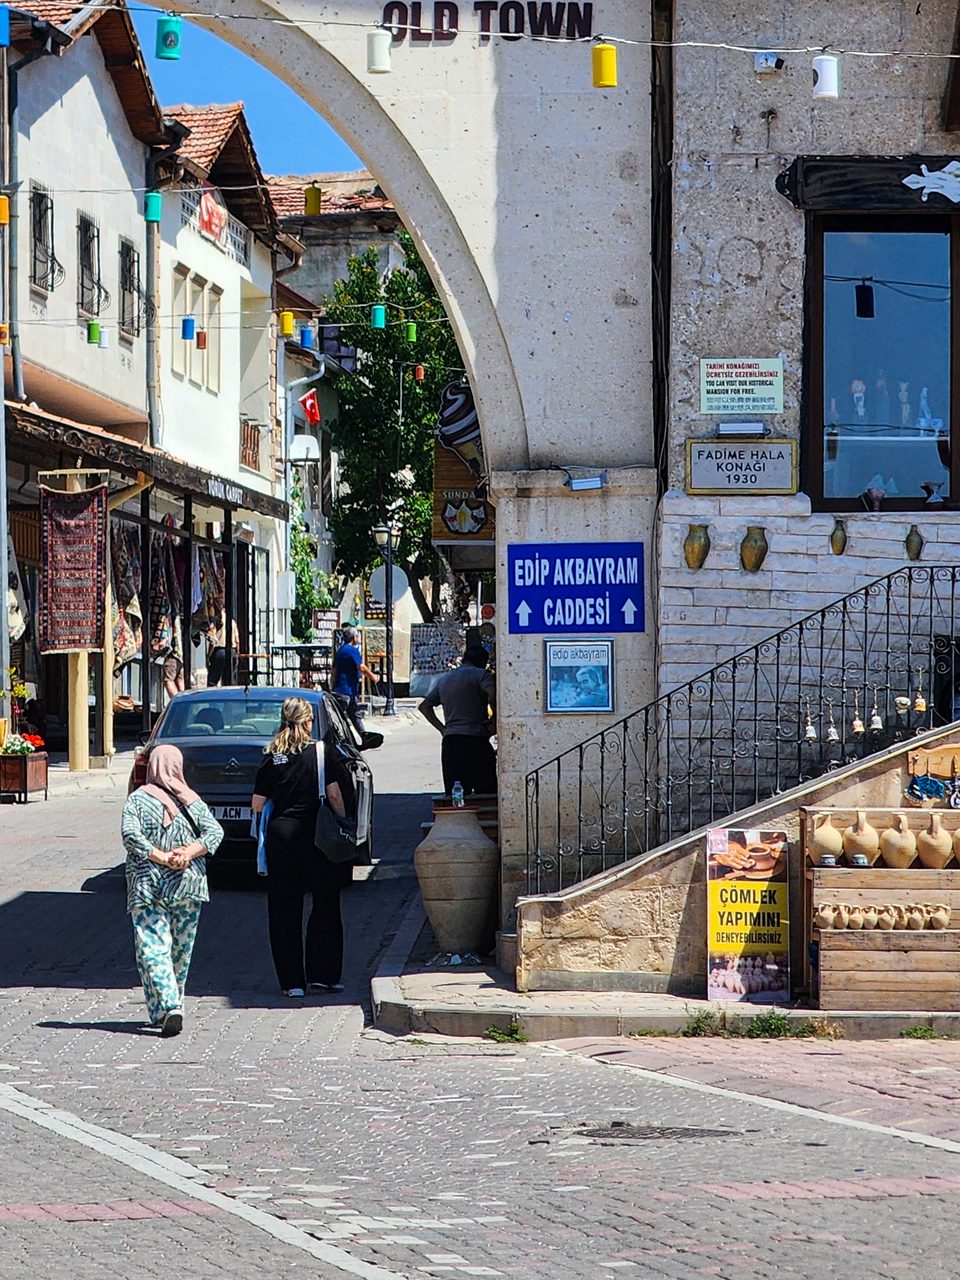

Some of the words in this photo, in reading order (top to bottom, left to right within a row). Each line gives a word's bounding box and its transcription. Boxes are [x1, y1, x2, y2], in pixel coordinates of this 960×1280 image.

[383, 0, 459, 42] OLD
[474, 0, 593, 42] TOWN
[697, 448, 746, 460] FADİME
[750, 450, 785, 460] HALA
[716, 460, 766, 472] KONAĞI
[726, 474, 758, 484] 1930
[514, 552, 550, 586] EDİP
[553, 557, 638, 586] AKBAYRAM
[543, 591, 611, 626] CADDESİ
[552, 649, 569, 661] edip
[570, 649, 607, 661] akbayram
[222, 807, 242, 819] ACN
[719, 885, 777, 908] ÇÖMLEK
[717, 911, 781, 928] YAPIMINI
